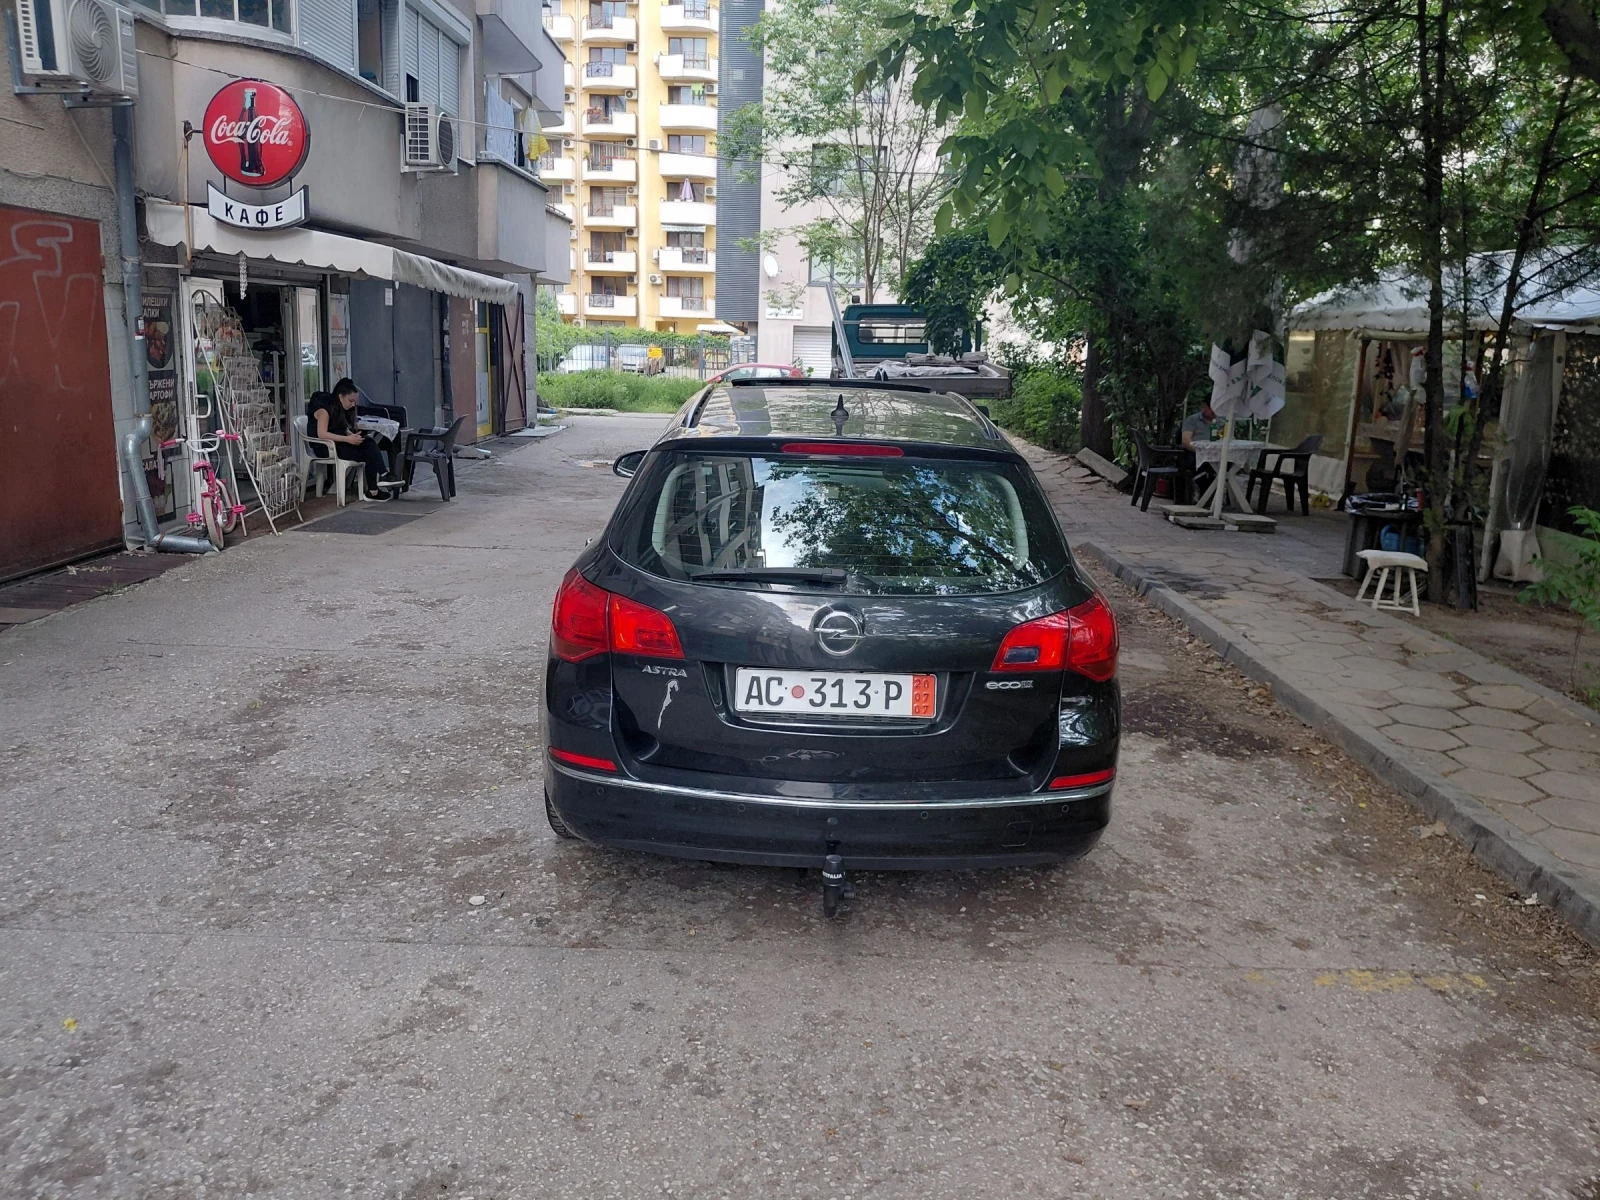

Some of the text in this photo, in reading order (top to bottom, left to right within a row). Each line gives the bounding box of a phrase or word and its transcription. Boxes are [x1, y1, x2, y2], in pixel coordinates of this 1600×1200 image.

[225, 202, 284, 226] КАФЕ
[142, 296, 168, 307] ИЛЕШКИ
[142, 308, 160, 318] АПКИ
[149, 378, 175, 389] ЪРЖЕНИ
[150, 389, 174, 400] АРТОФИ
[642, 665, 688, 678] ASTRA
[809, 678, 871, 708] 313
